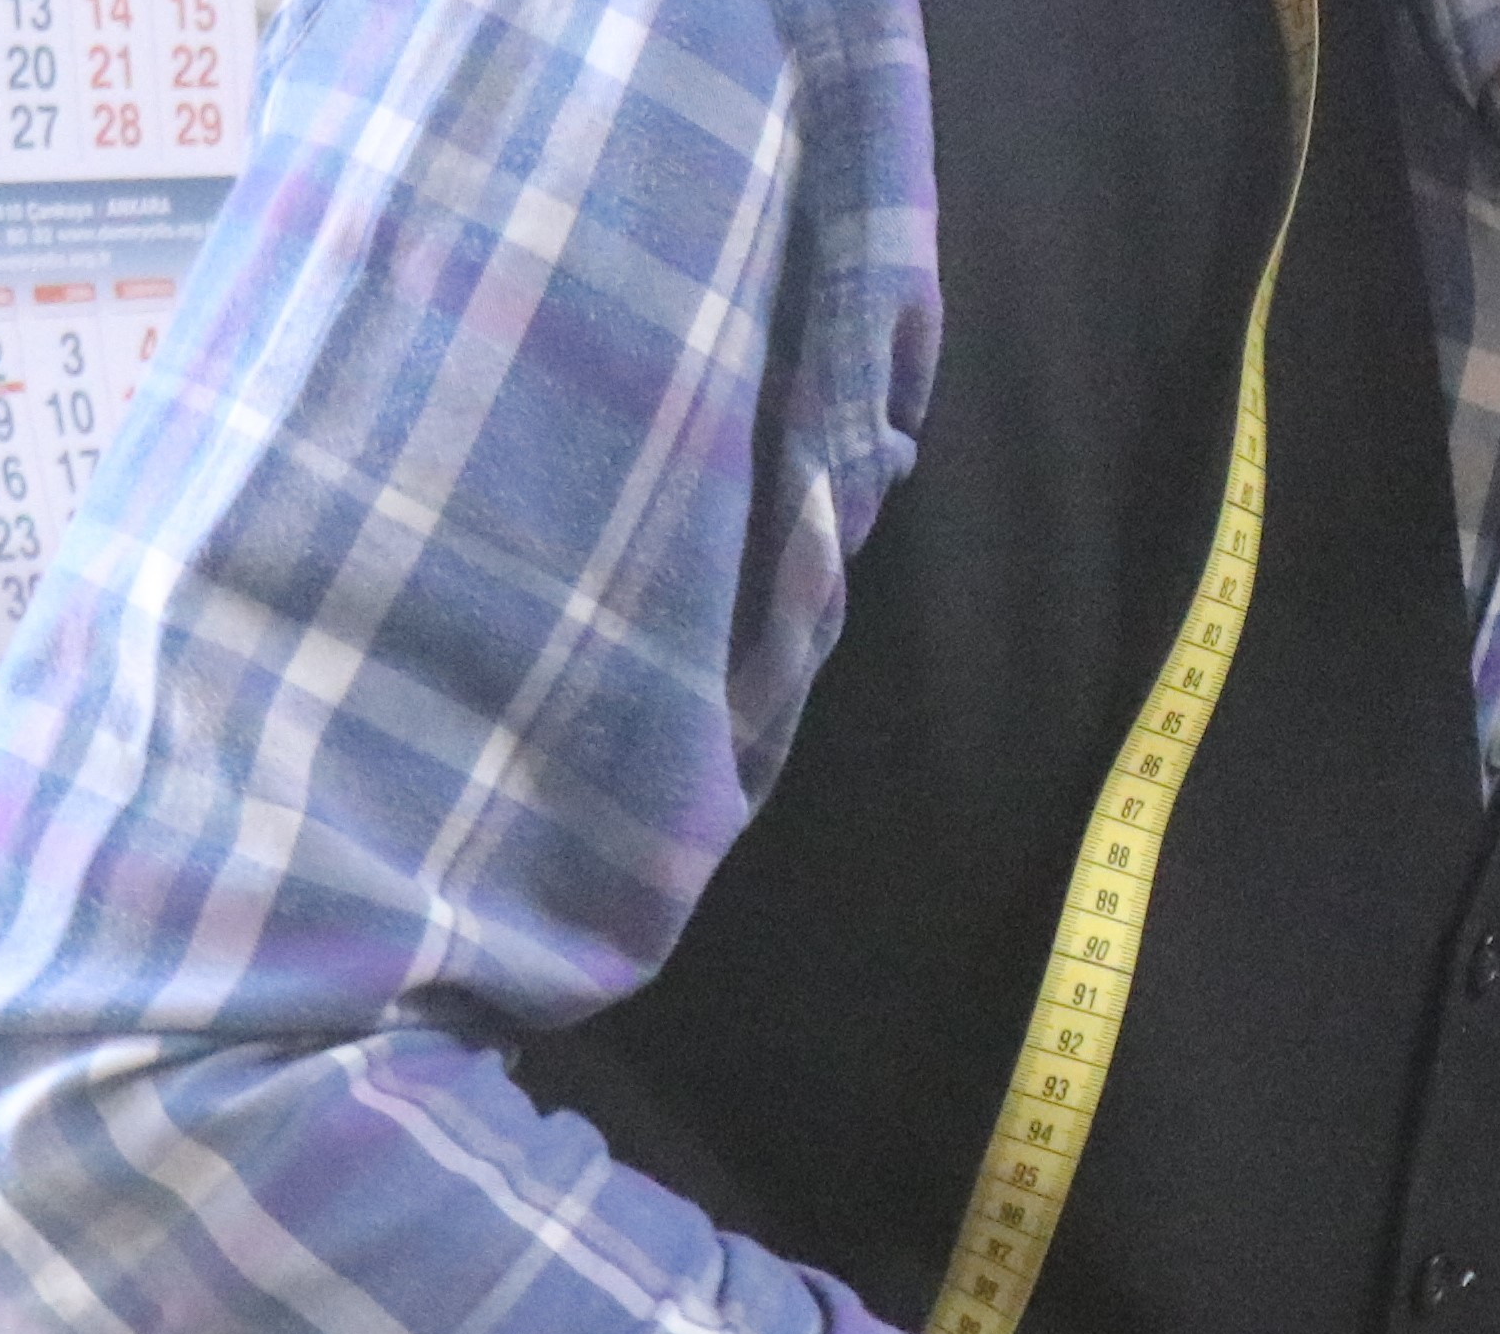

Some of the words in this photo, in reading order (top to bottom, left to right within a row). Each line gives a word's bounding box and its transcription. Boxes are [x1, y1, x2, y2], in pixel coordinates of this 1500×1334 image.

[7, 45, 56, 90] 20
[89, 44, 131, 89] 21
[172, 44, 218, 89] 22
[11, 104, 58, 149] 27
[94, 103, 141, 148] 28
[176, 102, 222, 146] 29
[60, 331, 84, 377] 3
[46, 390, 94, 435] 10
[1219, 576, 1236, 602] 82
[1202, 622, 1222, 647] 83
[1183, 667, 1204, 690] 84
[1161, 711, 1187, 734] 85
[1140, 754, 1163, 777] 86
[1121, 797, 1144, 820] 87
[1107, 842, 1130, 868] 88
[1095, 889, 1119, 915] 89
[1083, 936, 1110, 961] 90
[1072, 982, 1098, 1009] 91
[1057, 1029, 1083, 1055] 92
[1042, 1076, 1070, 1101] 93
[1027, 1118, 1054, 1145] 94
[1012, 1162, 1039, 1188] 95
